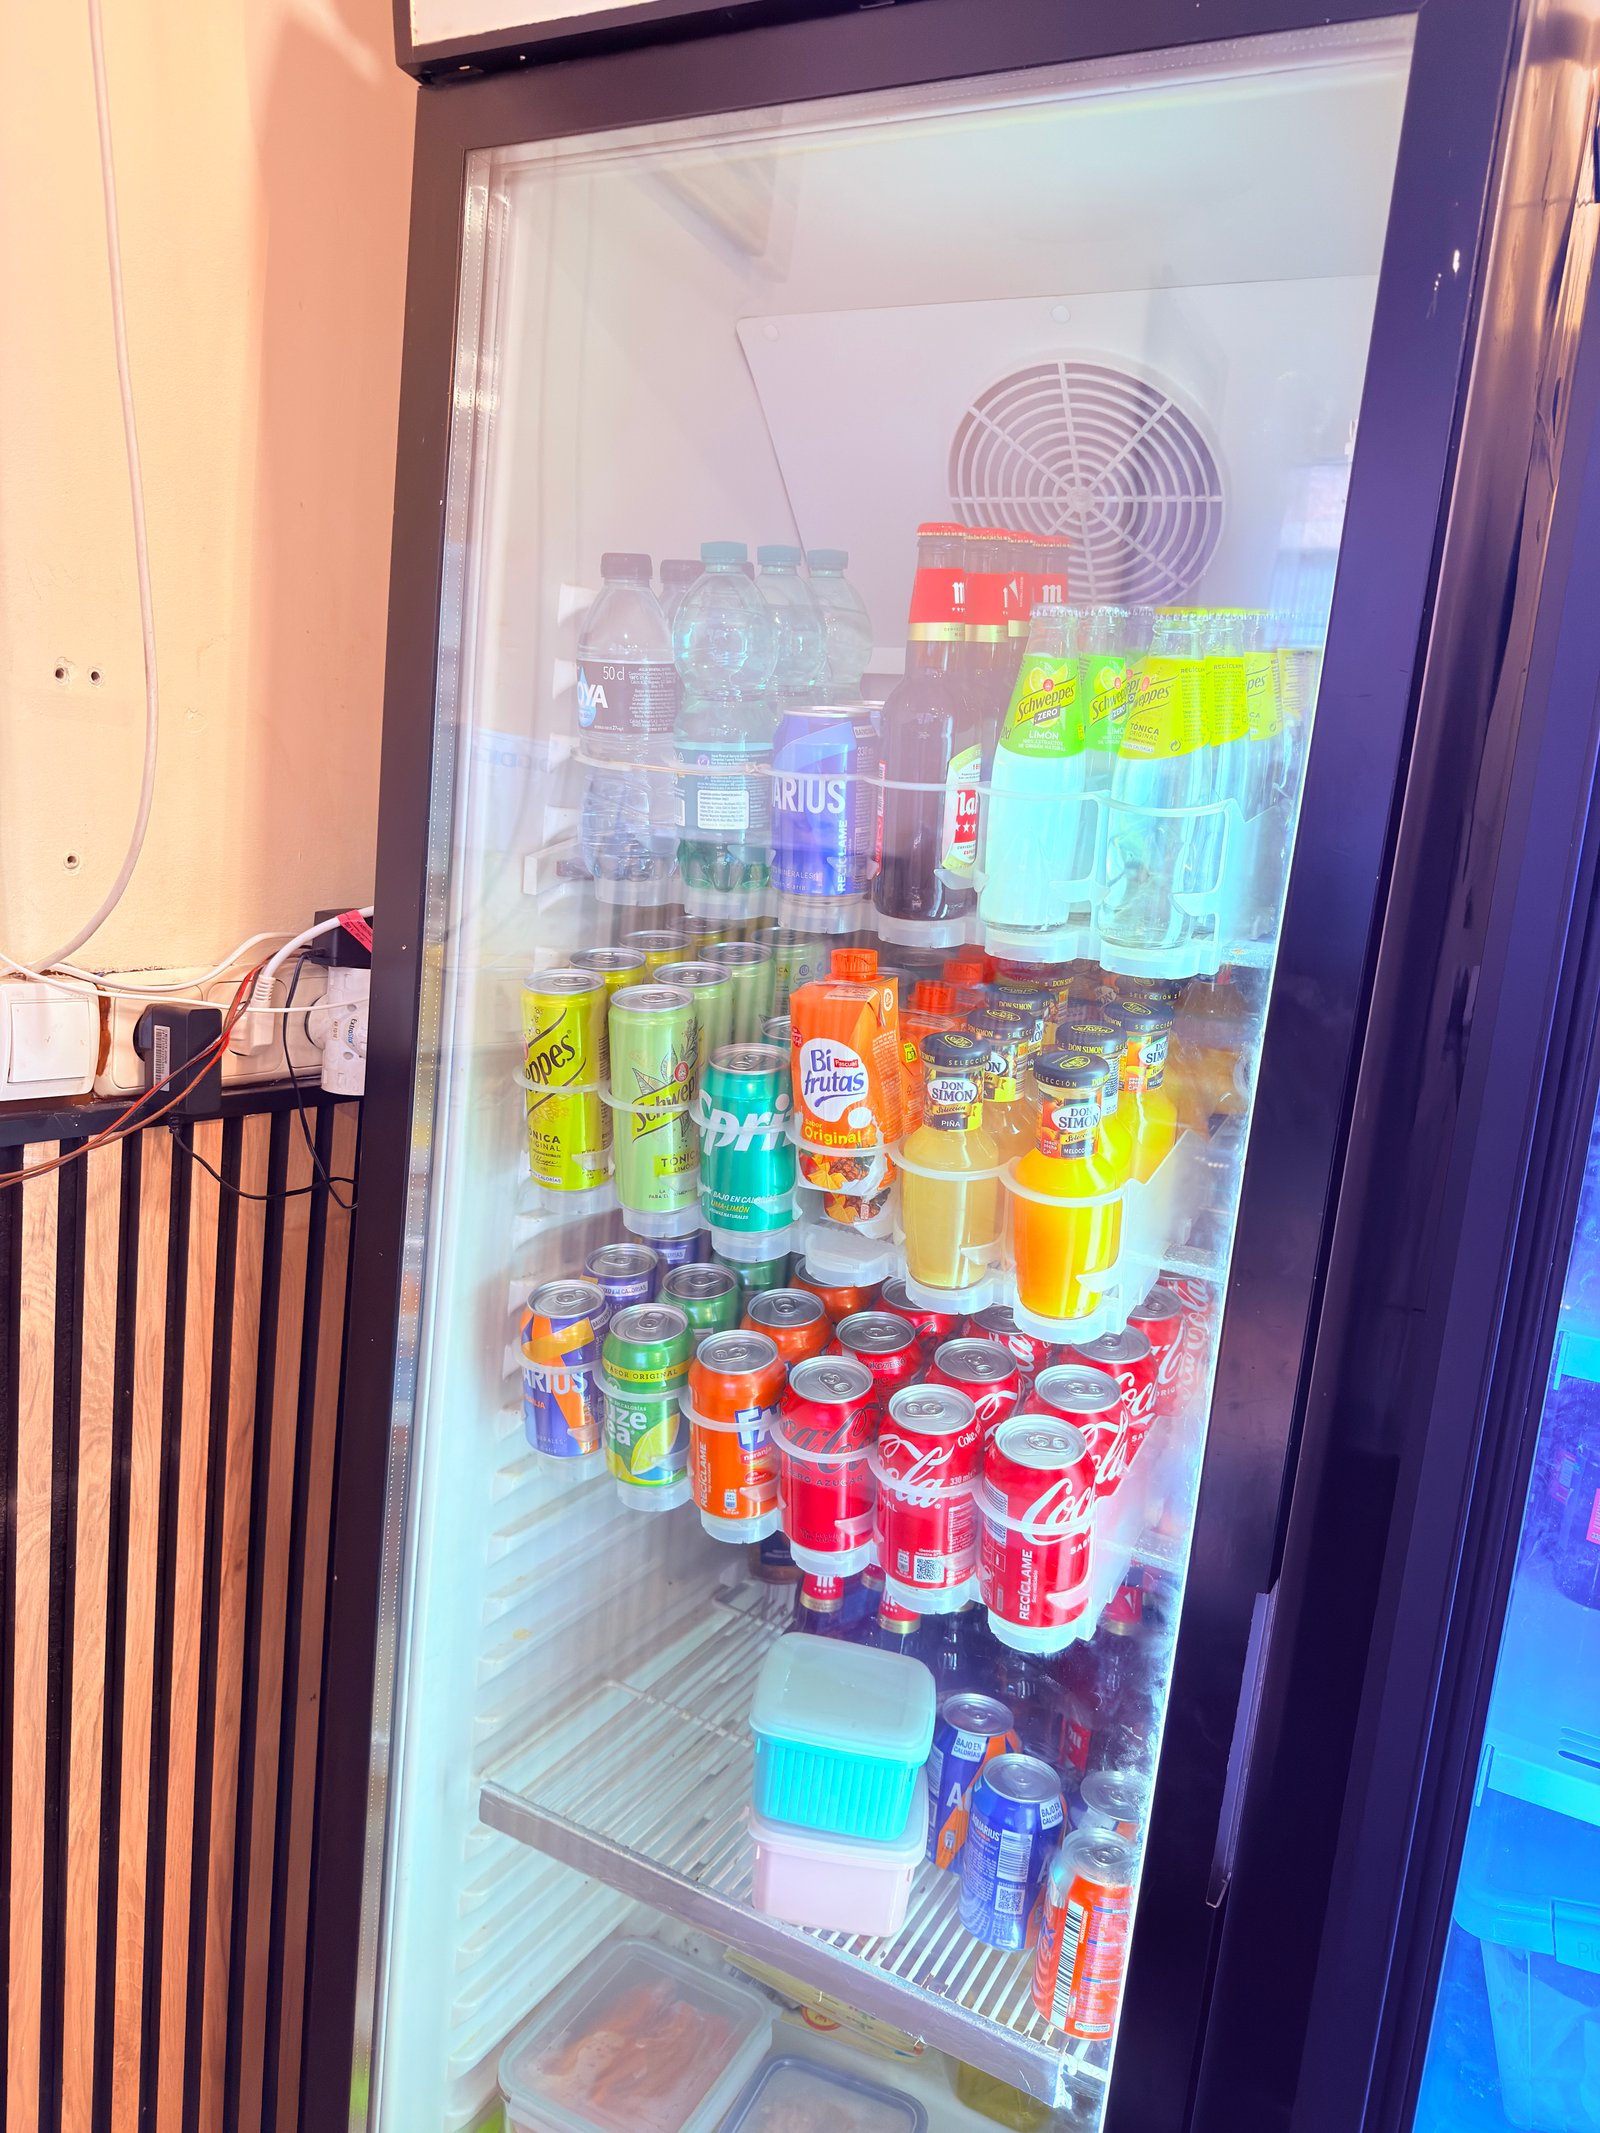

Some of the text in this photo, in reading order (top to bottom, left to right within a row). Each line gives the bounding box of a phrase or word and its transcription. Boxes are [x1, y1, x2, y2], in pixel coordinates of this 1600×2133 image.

[603, 666, 615, 680] 50
[1017, 685, 1075, 723] Schweppes
[1037, 708, 1058, 720] ZERO
[1029, 729, 1059, 740] LIMÓN
[1131, 722, 1159, 736] TÓNICA
[1068, 1043, 1104, 1054] DON SIMON
[810, 1049, 831, 1073] Bi
[834, 1058, 858, 1068] Pascual
[804, 1071, 864, 1096] frutas
[941, 1080, 964, 1091] DON
[932, 1088, 973, 1102] SIMON
[1070, 1108, 1093, 1117] DON
[805, 1119, 822, 1128] sabor
[941, 1119, 960, 1127] PIÑA
[1058, 1113, 1099, 1129] SIMON
[804, 1126, 861, 1146] Original
[713, 1190, 730, 1201] BAJO
[633, 1369, 678, 1380] ORIGINAL
[1019, 1549, 1033, 1621] RECÍCLAME
[956, 1737, 982, 1751] BAJO EN
[953, 1746, 980, 1759] CALORÍAS
[971, 1813, 1000, 1842] AQUARIUS
